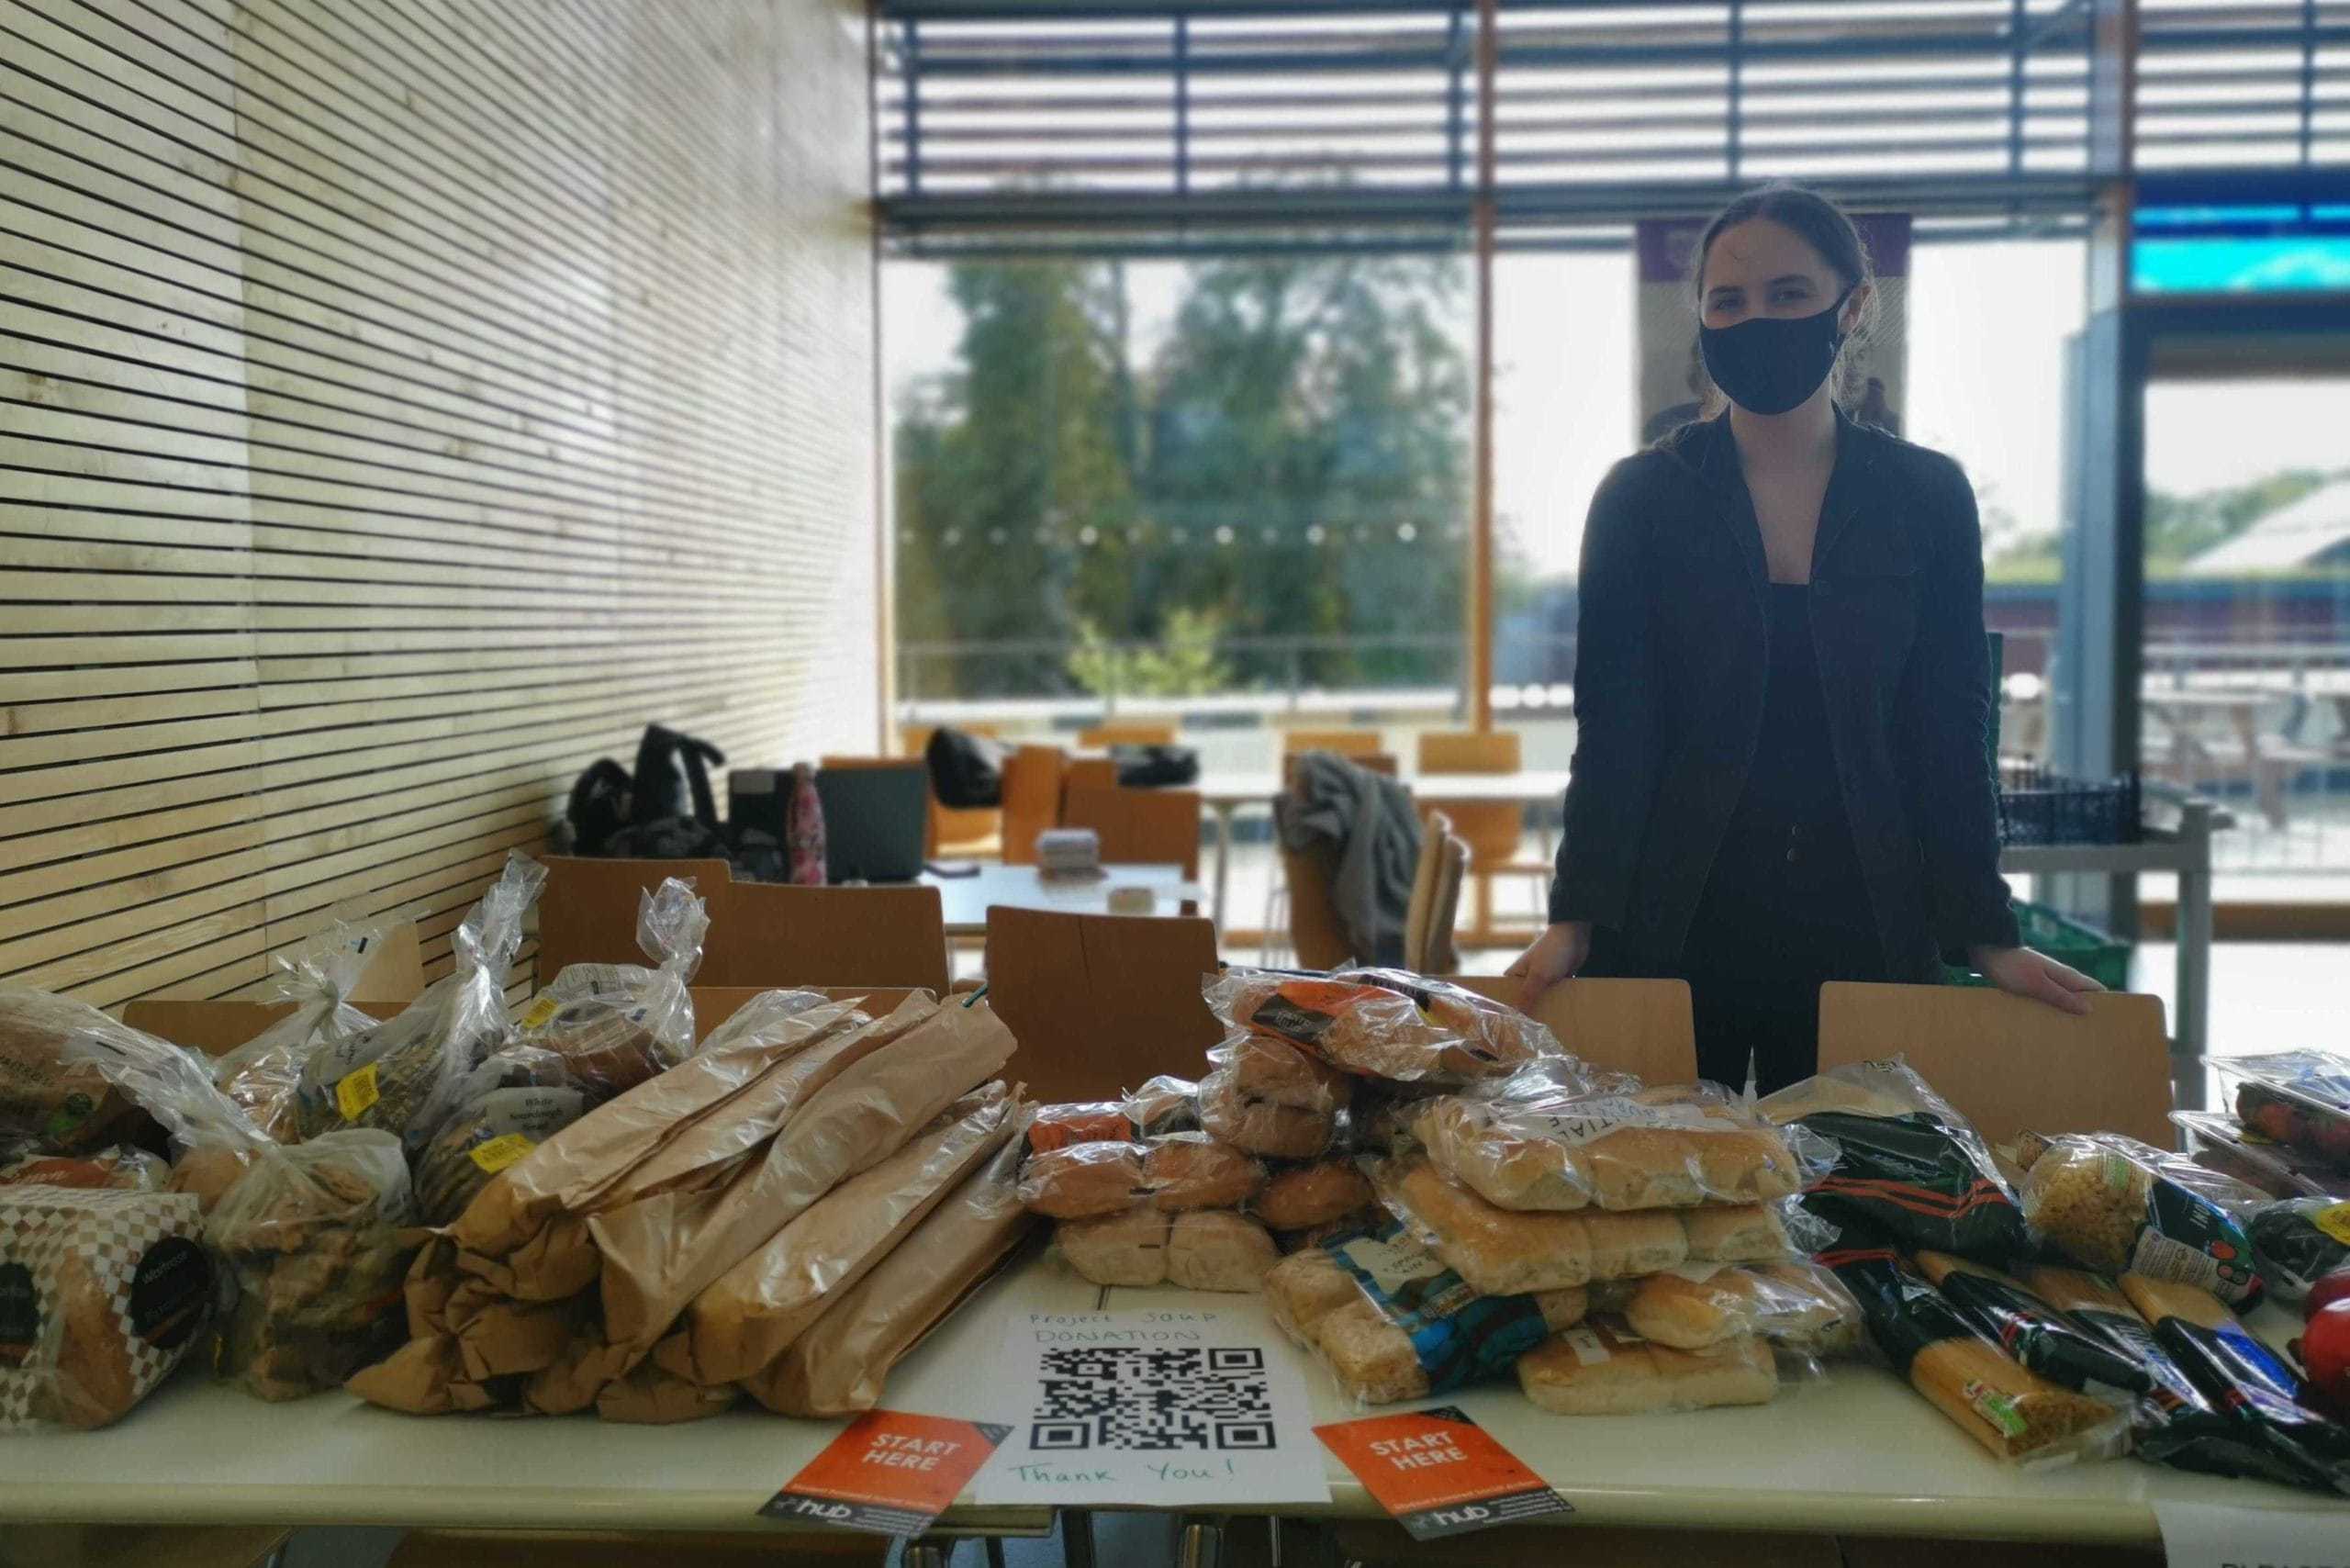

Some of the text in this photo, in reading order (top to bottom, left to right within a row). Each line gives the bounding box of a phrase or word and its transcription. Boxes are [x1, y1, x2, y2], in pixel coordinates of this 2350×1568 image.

[1029, 1312, 1113, 1327] Project
[1035, 1329, 1202, 1344] DONATION
[871, 1433, 961, 1456] START
[1370, 1430, 1455, 1457] START
[861, 1450, 939, 1472] HERE
[1391, 1446, 1468, 1471] HERE
[1008, 1458, 1235, 1484] Thank You!
[795, 1498, 853, 1519] hub
[1432, 1506, 1490, 1527] hub
